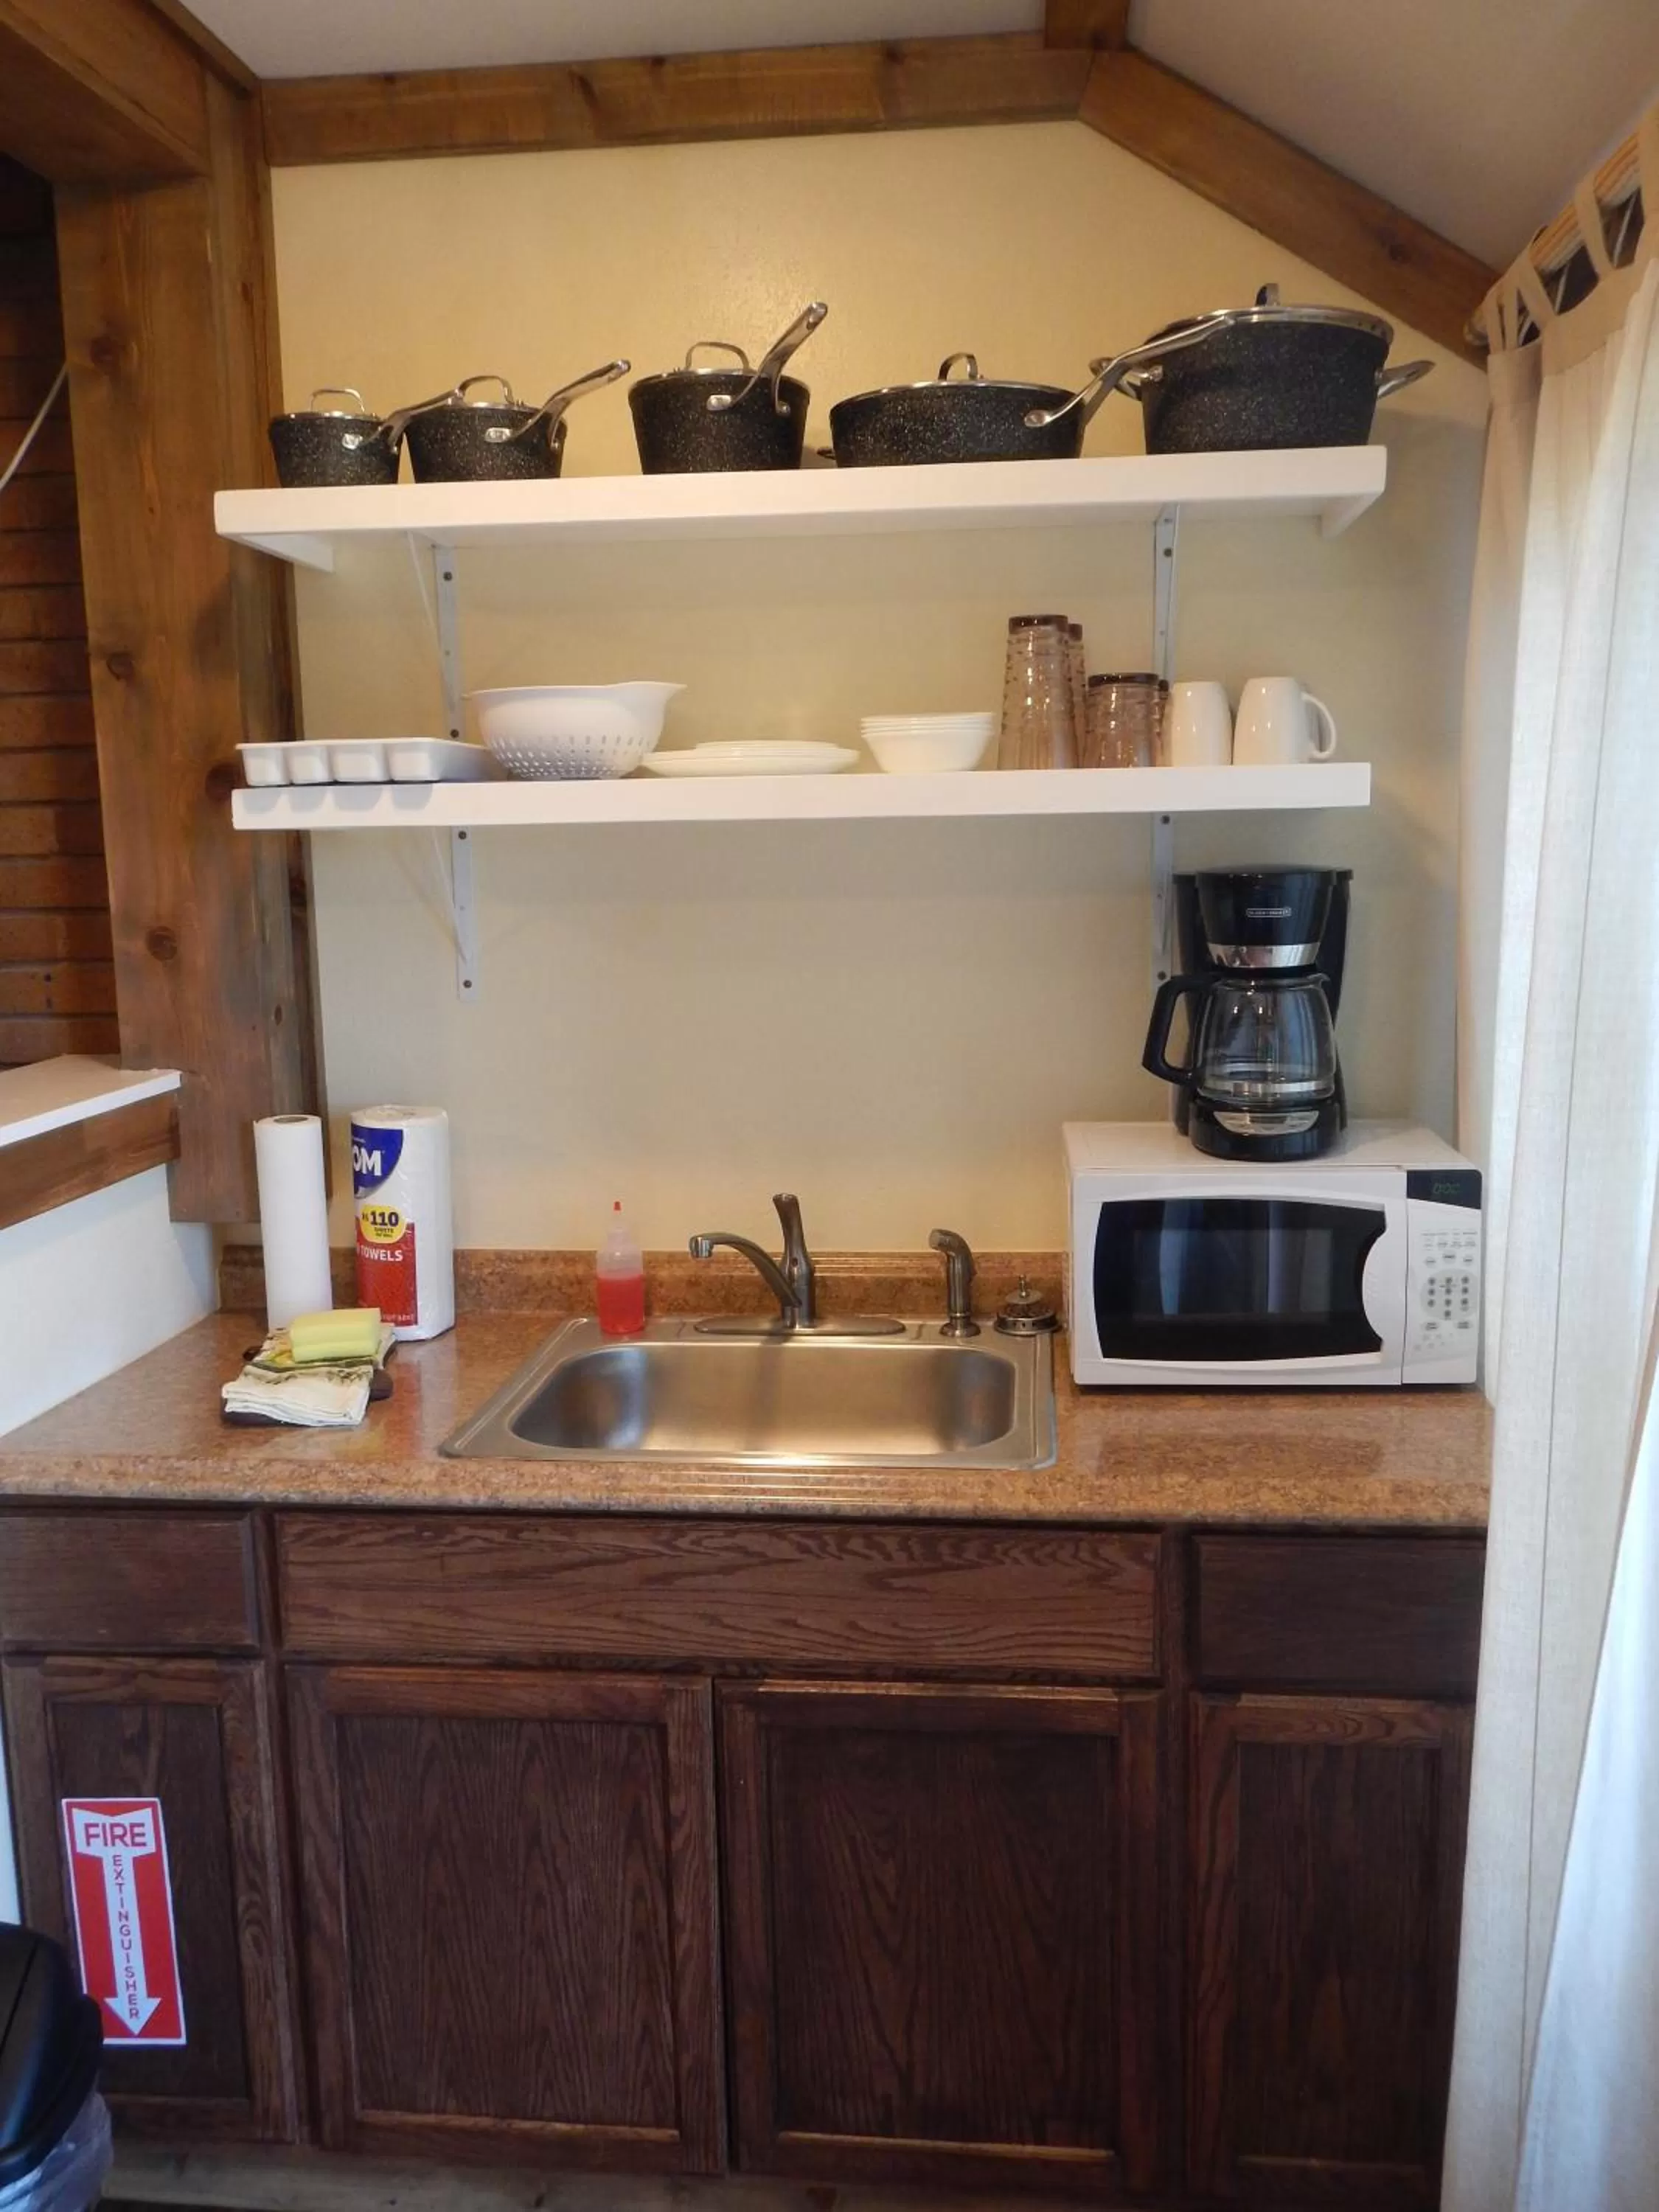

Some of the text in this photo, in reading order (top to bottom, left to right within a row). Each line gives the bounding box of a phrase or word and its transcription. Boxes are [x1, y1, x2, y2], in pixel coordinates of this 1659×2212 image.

[370, 1211, 399, 1227] 110
[361, 1245, 403, 1262] TOWELS
[84, 1823, 147, 1847] FIRE
[113, 1854, 139, 2020] EXTINGUISHER
